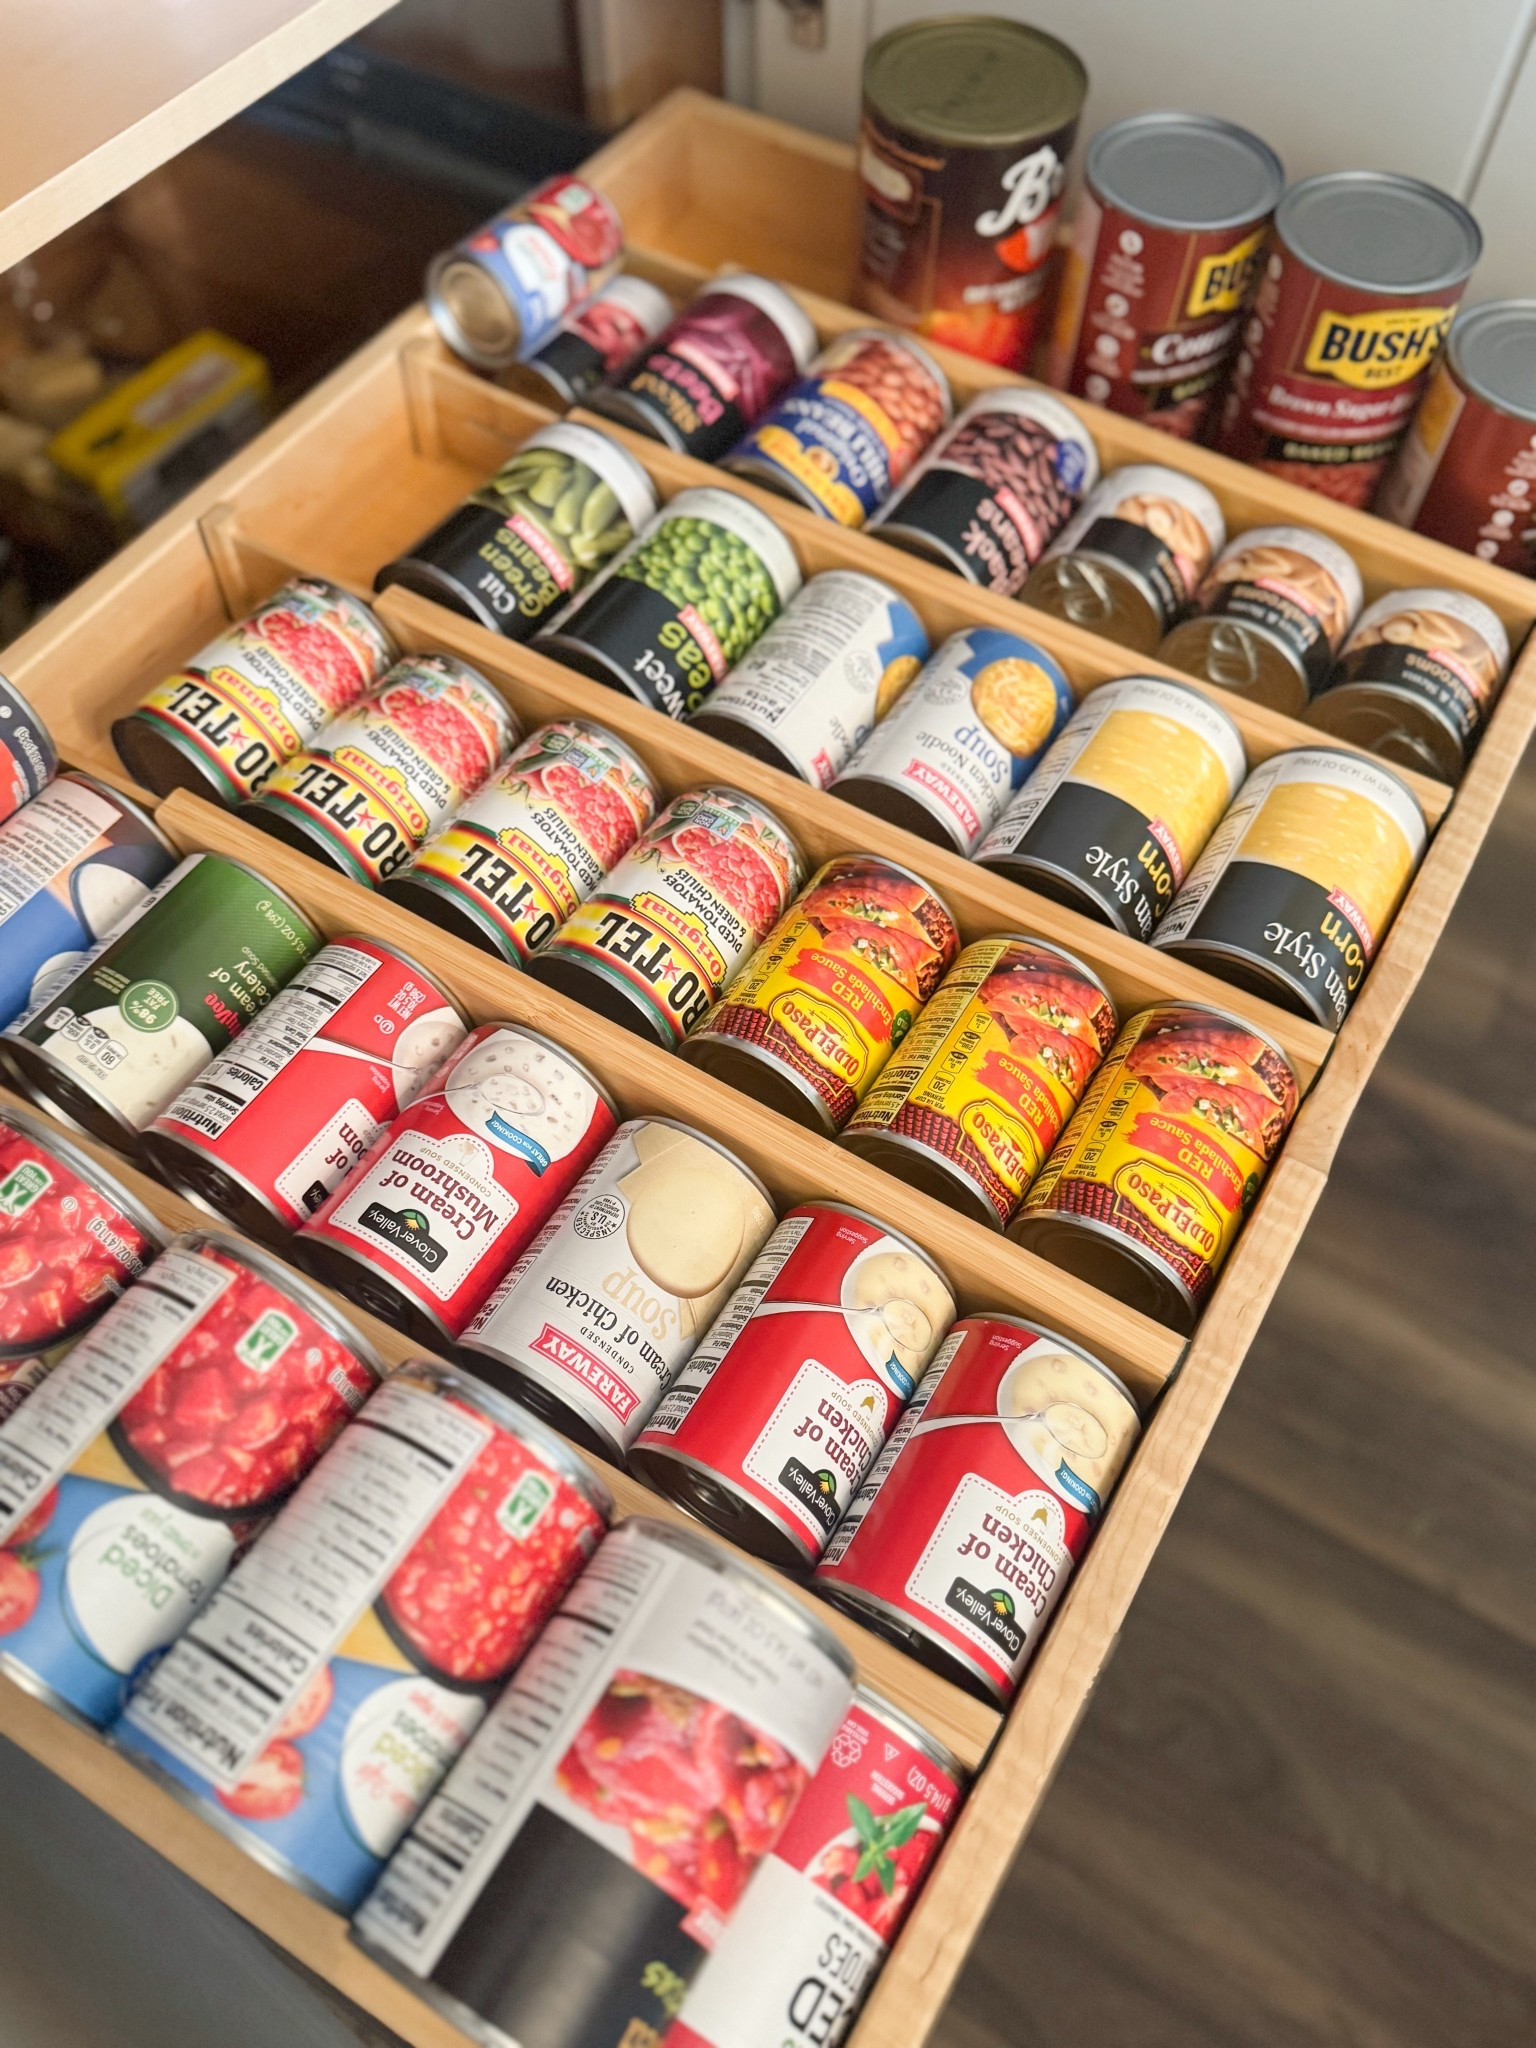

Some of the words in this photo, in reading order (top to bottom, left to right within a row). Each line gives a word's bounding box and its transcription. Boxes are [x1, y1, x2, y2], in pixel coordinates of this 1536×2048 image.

[478, 543, 543, 616] Green
[495, 527, 560, 607] Beans
[477, 572, 516, 614] Cut
[243, 651, 294, 705] TOMATOES
[745, 689, 786, 715] Facts
[292, 703, 321, 731] DICED
[379, 723, 414, 758] CHILIES
[915, 732, 968, 769] Noodle
[954, 725, 1008, 783] Soup
[366, 730, 421, 781] TOMATOES
[413, 754, 443, 786] GREEN
[341, 750, 423, 830] Original
[419, 780, 447, 809] DICED
[907, 763, 978, 831] FAREWAY
[543, 807, 577, 846] CHILIES
[530, 812, 579, 872] TOMATOES
[575, 843, 599, 873] GREEN
[674, 868, 710, 904] CHILIES
[1085, 846, 1139, 904] Style
[663, 874, 716, 927] TOMATOES
[710, 898, 739, 929] GREEN
[280, 925, 296, 941] OZ
[641, 897, 721, 977] Original
[714, 923, 742, 953] DICED
[739, 928, 747, 937] &
[1263, 922, 1325, 978] Style
[208, 967, 230, 984] of
[811, 953, 848, 979] Sauce
[143, 996, 161, 1010] FAT
[147, 987, 170, 1006] FREE
[387, 998, 401, 1011] WT
[402, 997, 418, 1011] 10.5
[832, 982, 864, 1013] RED
[847, 974, 892, 1025] Enchilada
[127, 1000, 157, 1024] 98%
[396, 1006, 412, 1020] NET
[101, 1052, 115, 1065] 60
[227, 1066, 264, 1091] Calories
[882, 1071, 919, 1080] Calories
[999, 1057, 1033, 1092] Sauce
[170, 1106, 222, 1135] Nutrition
[216, 1098, 239, 1115] Serving
[1019, 1093, 1045, 1127] RED
[491, 1120, 523, 1145] COOKING!
[1149, 1117, 1193, 1145] Sauce
[325, 1148, 348, 1173] of
[420, 1146, 444, 1164] SOUP
[530, 1147, 548, 1167] GREAT
[1177, 1147, 1214, 1179] RED
[1191, 1139, 1243, 1193] Enchilada
[14, 1173, 39, 1191] GREAT
[21, 1166, 37, 1179] YOU
[380, 1169, 409, 1188] of
[443, 1159, 492, 1198] CONDENSED
[392, 1149, 500, 1233] Mushroom
[409, 1175, 476, 1241] Cream
[591, 1211, 607, 1225] U.S.
[576, 1218, 611, 1237] INSPECTED
[836, 1230, 857, 1246] Serving
[839, 1226, 868, 1244] Suggestion
[545, 1276, 619, 1332] Chicken
[579, 1325, 635, 1374] CONDENSED
[613, 1324, 640, 1348] of
[989, 1340, 1009, 1352] Serving
[992, 1334, 1023, 1350] Suggestion
[543, 1334, 631, 1413] FAREWAY
[638, 1341, 673, 1391] Cream
[676, 1393, 695, 1405] Serving
[831, 1390, 852, 1411] SOUP
[792, 1416, 824, 1441] of
[815, 1398, 872, 1471] Chicken
[823, 1438, 860, 1496] Cream
[1059, 1468, 1087, 1497] COOKING!
[995, 1503, 1024, 1529] SOUP
[956, 1532, 992, 1556] of
[979, 1513, 1058, 1591] Chicken
[1021, 1520, 1062, 1566] CONDENSED
[99, 1544, 172, 1609] Diced
[994, 1553, 1047, 1619] Cream
[906, 1765, 926, 1792] OZ)
